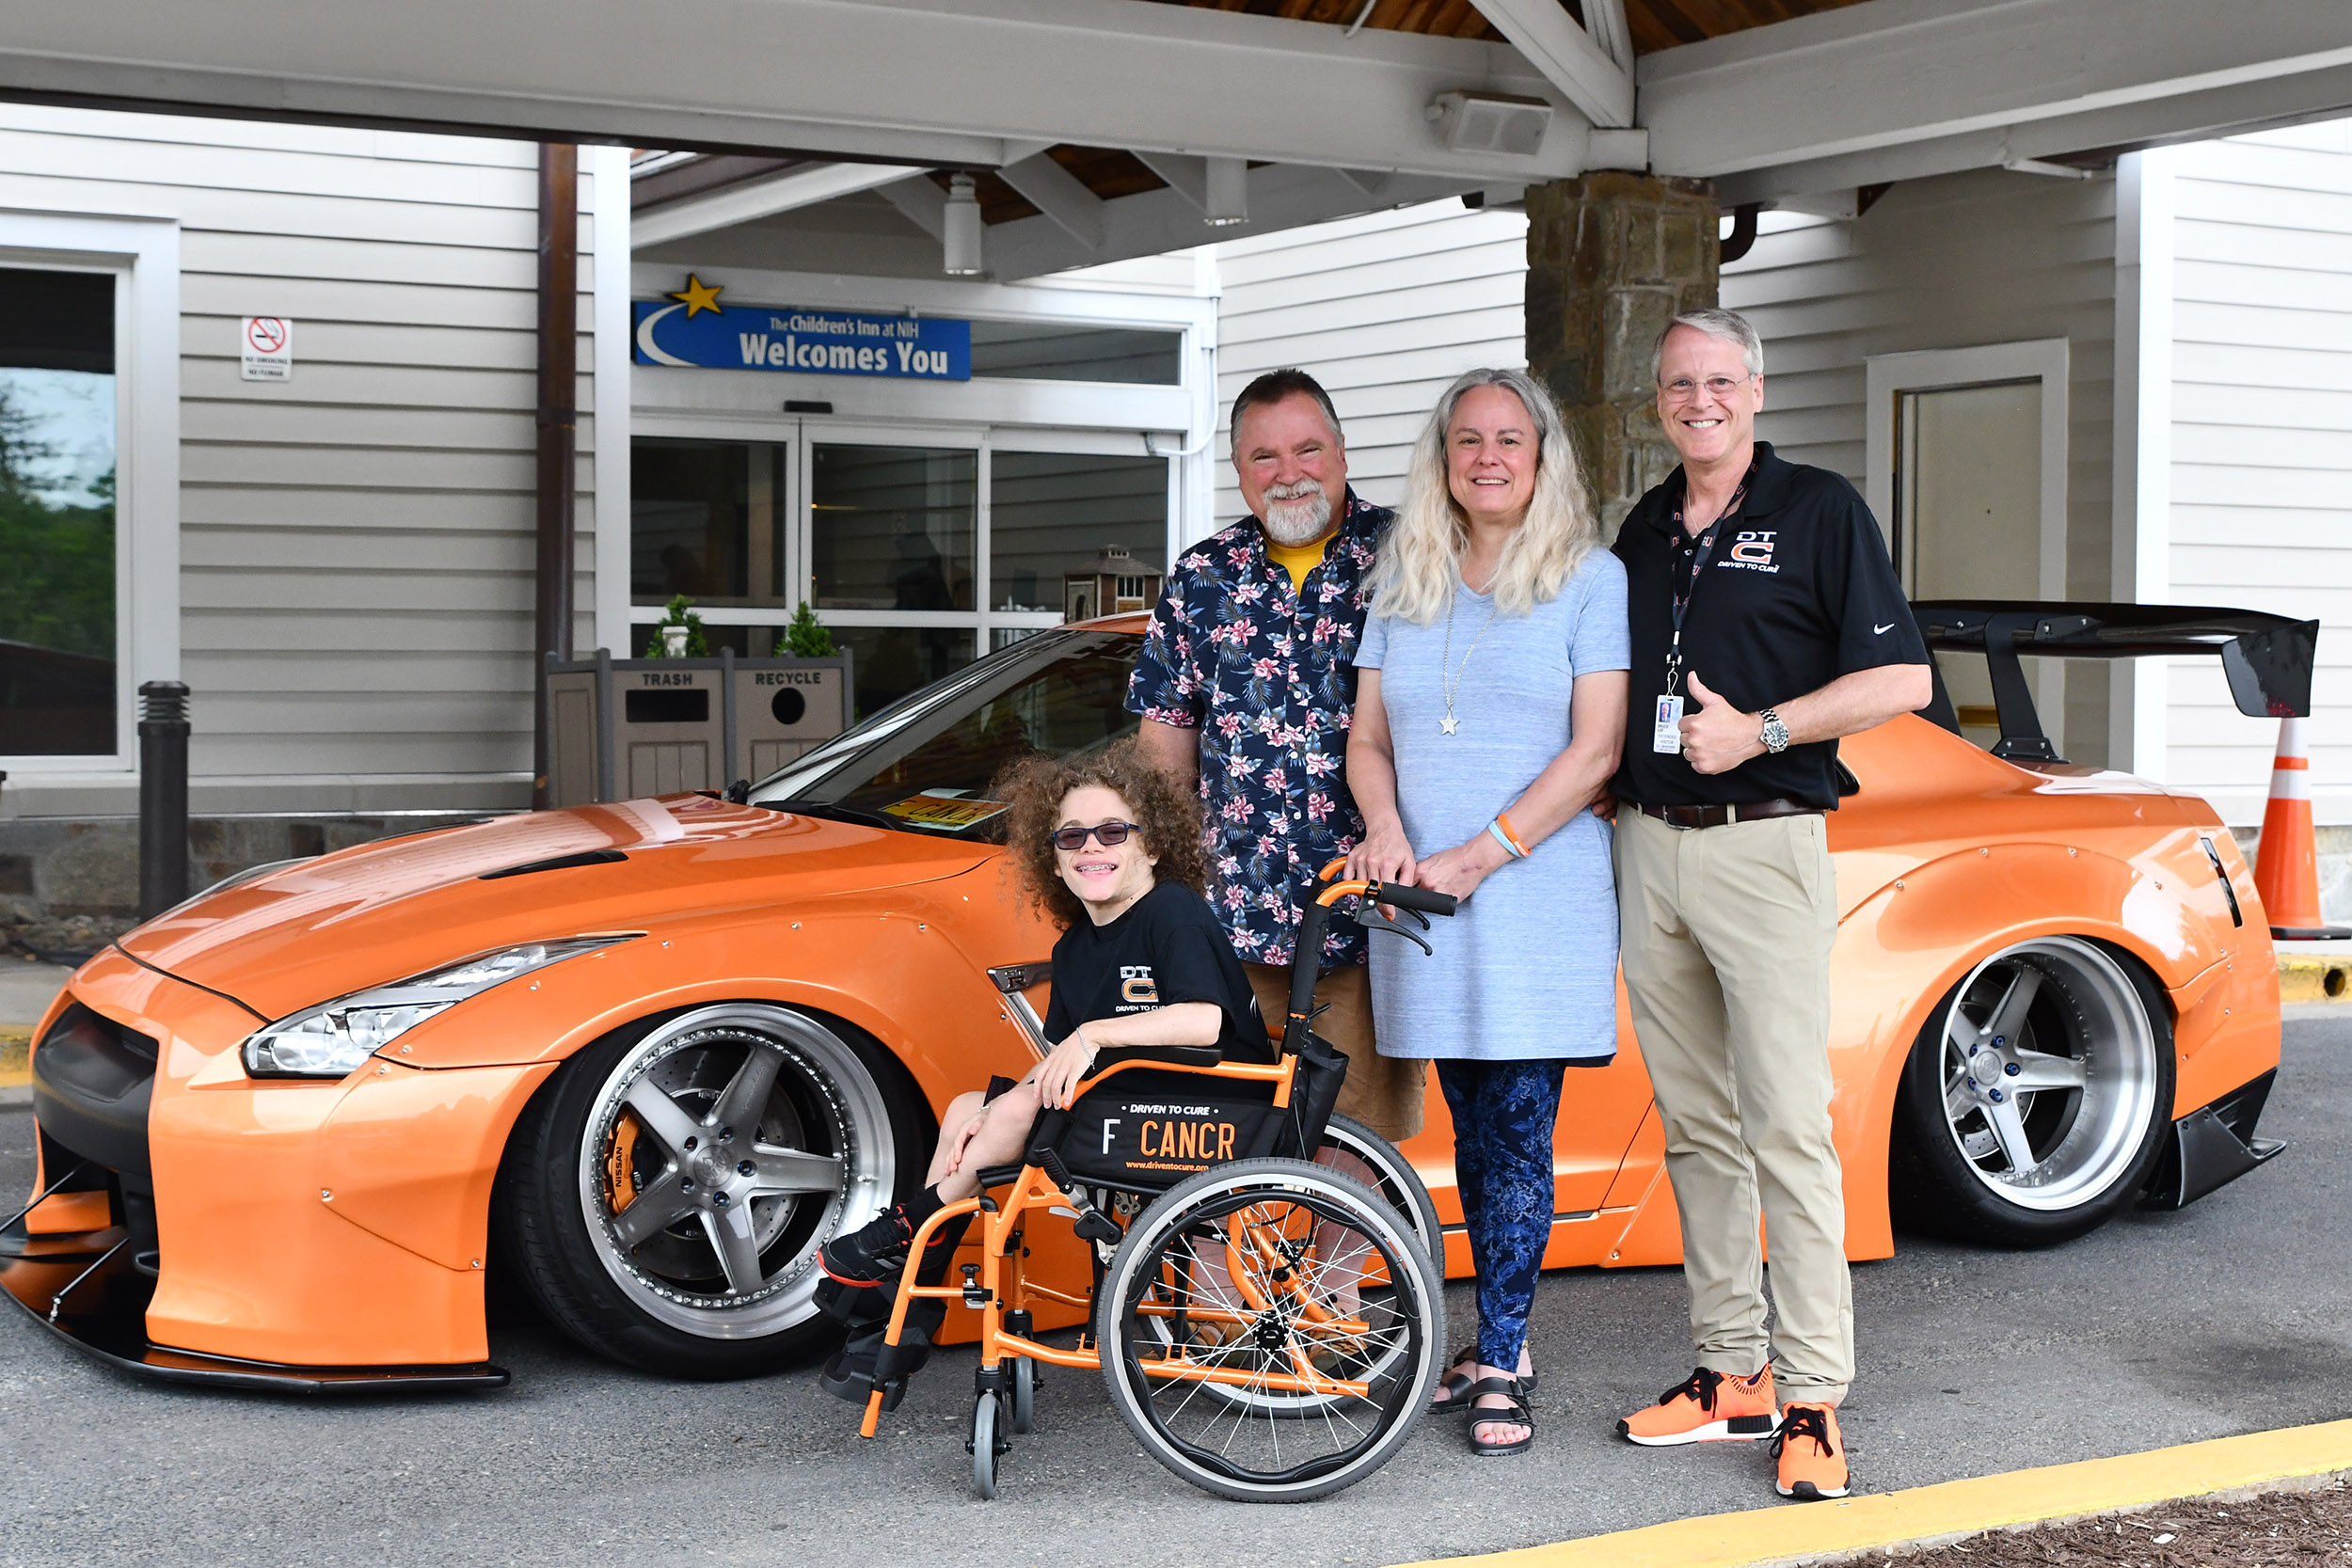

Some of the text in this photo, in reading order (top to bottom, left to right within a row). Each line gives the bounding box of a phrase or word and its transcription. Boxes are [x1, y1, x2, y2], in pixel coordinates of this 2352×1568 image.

[770, 314, 919, 339] The Children's Inn at NIH
[739, 332, 948, 374] Welcomes You
[1757, 564, 1780, 574] CURE
[642, 673, 693, 686] TRASH
[755, 672, 821, 686] RECYCLE
[1129, 1103, 1211, 1117] DRIVEN TO CURE
[1102, 1117, 1236, 1161] F CANCR
